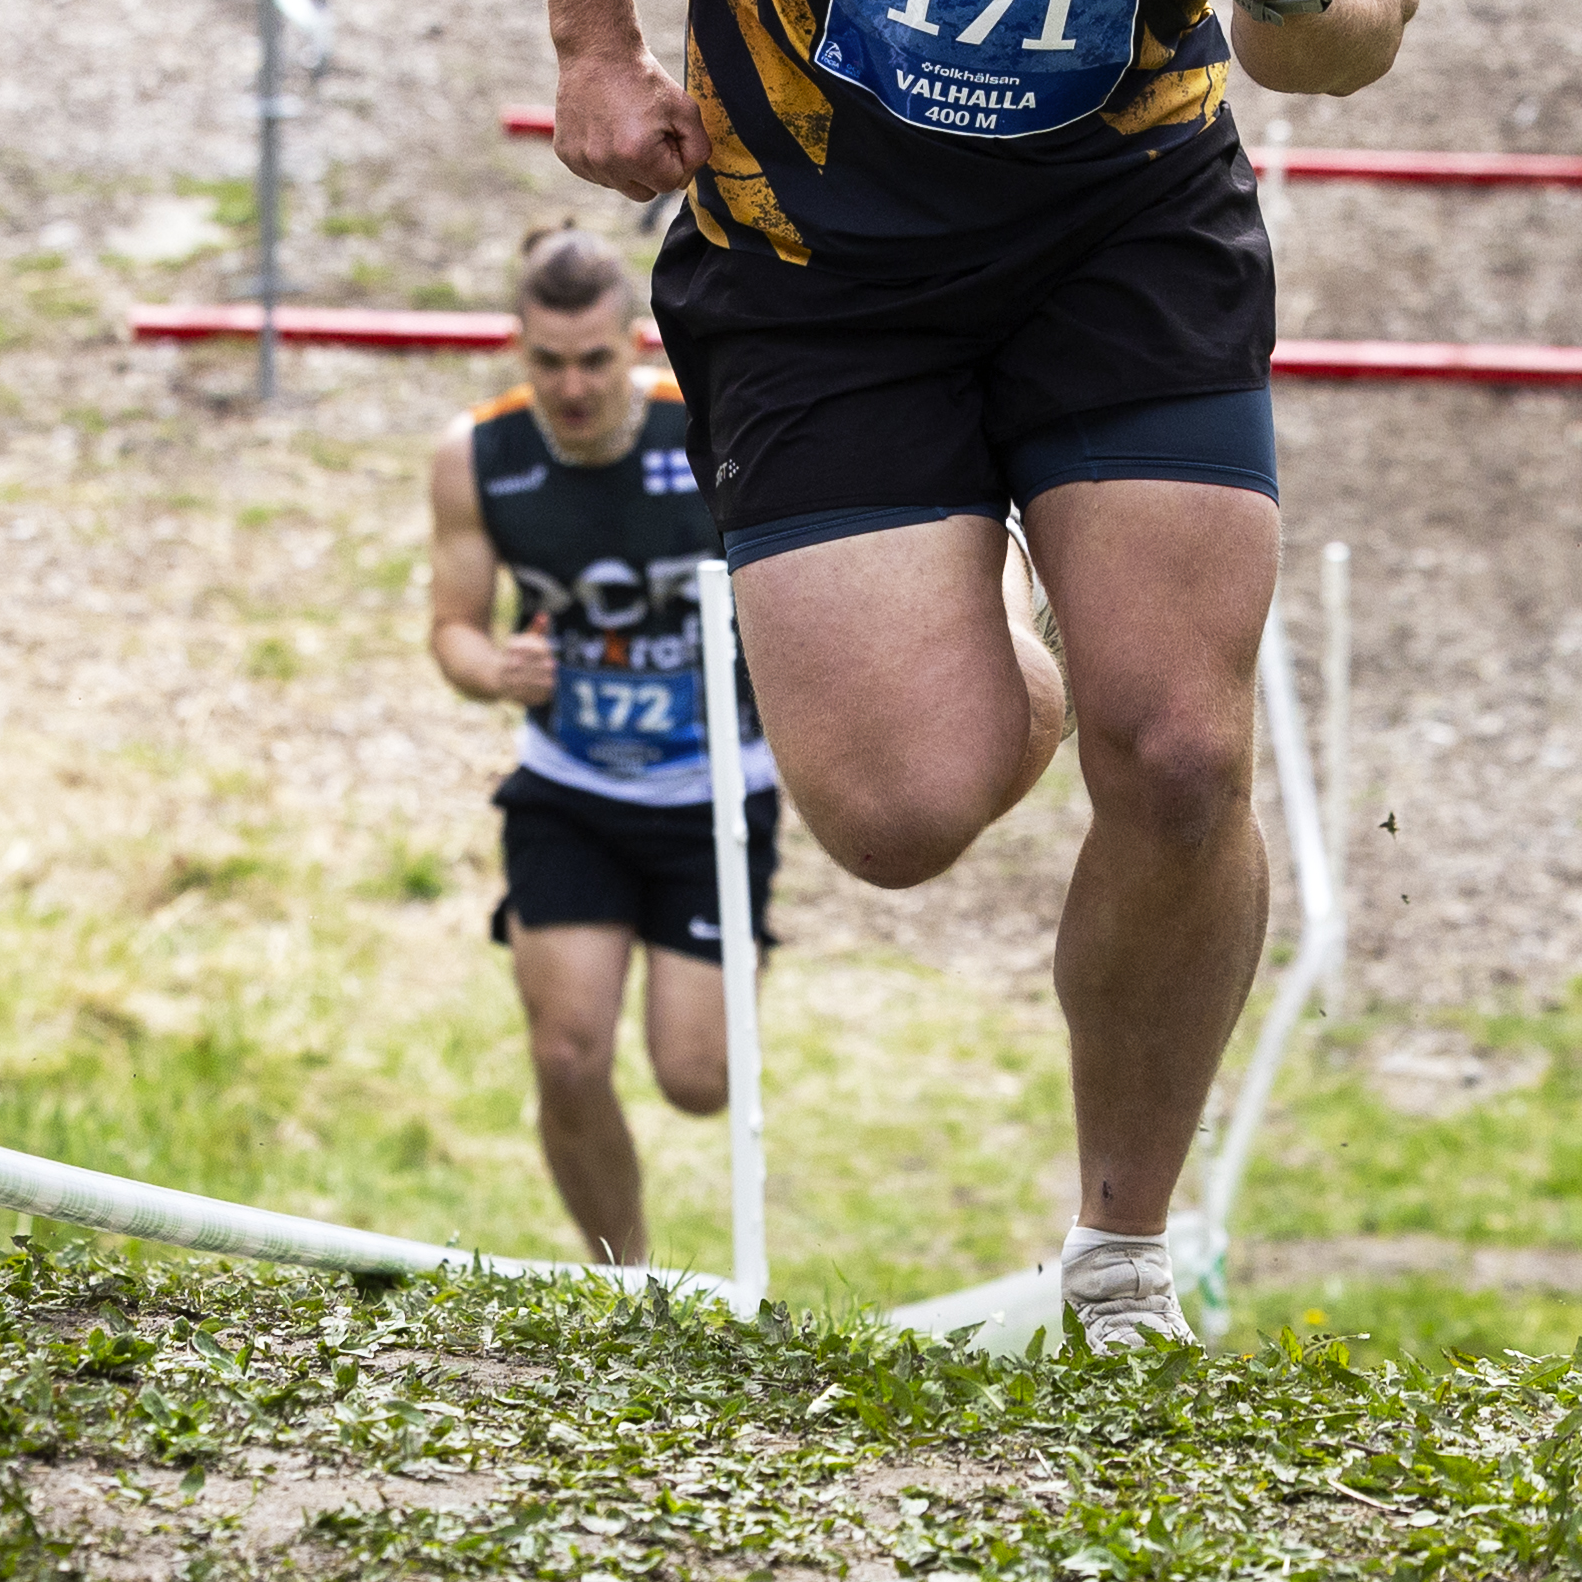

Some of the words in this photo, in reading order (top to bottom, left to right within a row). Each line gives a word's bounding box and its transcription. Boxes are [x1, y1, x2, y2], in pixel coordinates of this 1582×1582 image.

[896, 68, 1037, 110] VALHALLA
[934, 65, 1020, 86] folkhälsan
[925, 106, 970, 126] 400
[974, 113, 998, 130] M
[572, 679, 675, 733] 172
